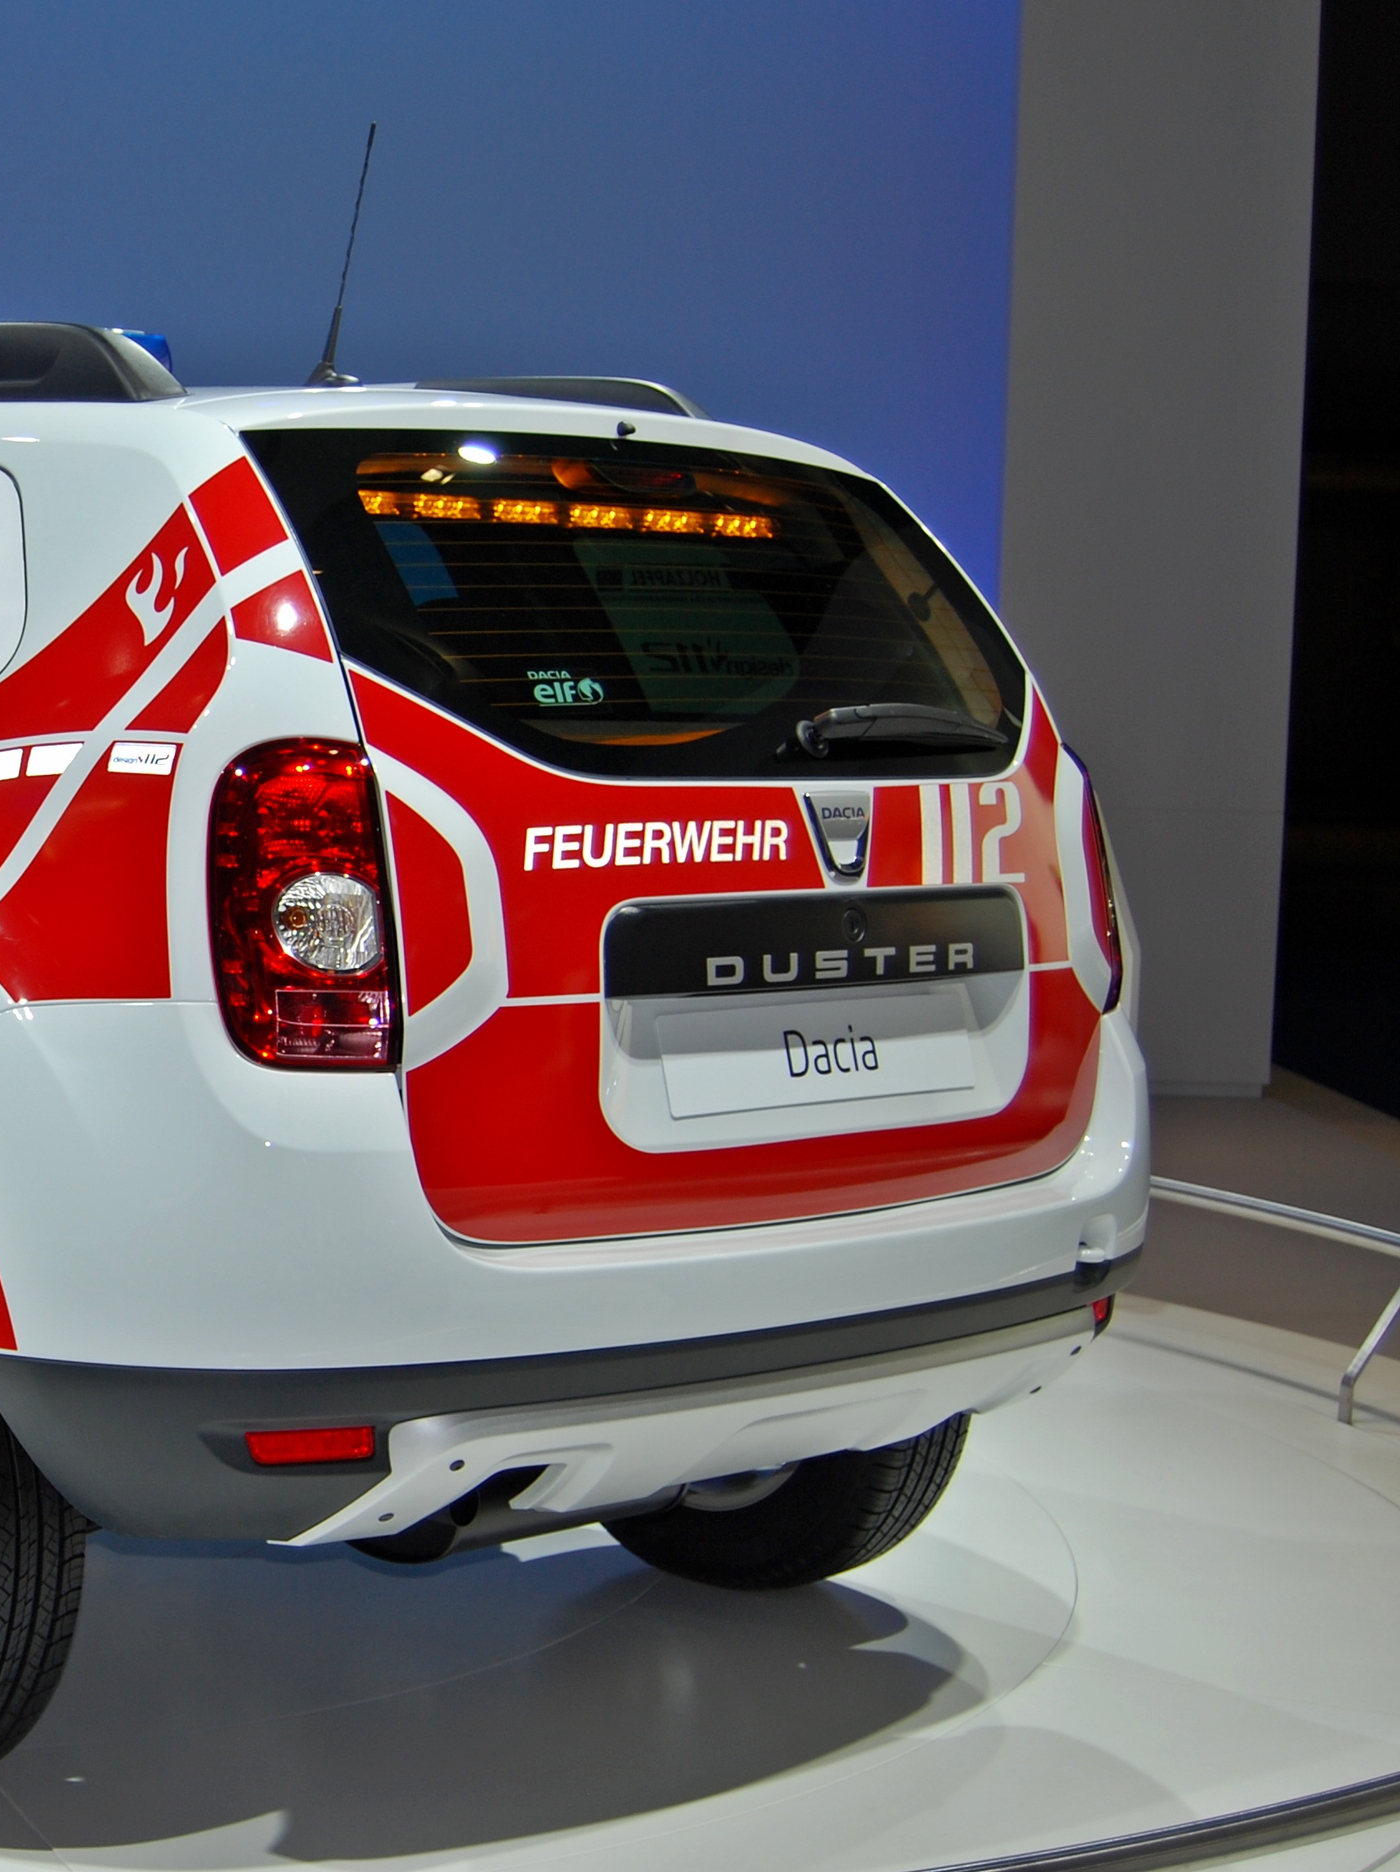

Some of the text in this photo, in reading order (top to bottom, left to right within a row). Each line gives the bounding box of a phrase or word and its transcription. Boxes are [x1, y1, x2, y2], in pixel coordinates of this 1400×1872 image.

[527, 670, 572, 680] DACIA
[533, 681, 576, 703] elf
[821, 806, 867, 820] DACIA
[920, 781, 1025, 885] 112
[523, 819, 789, 872] FEUERWEHR
[706, 942, 976, 987] DUSTER
[782, 1023, 880, 1078] Dacia
